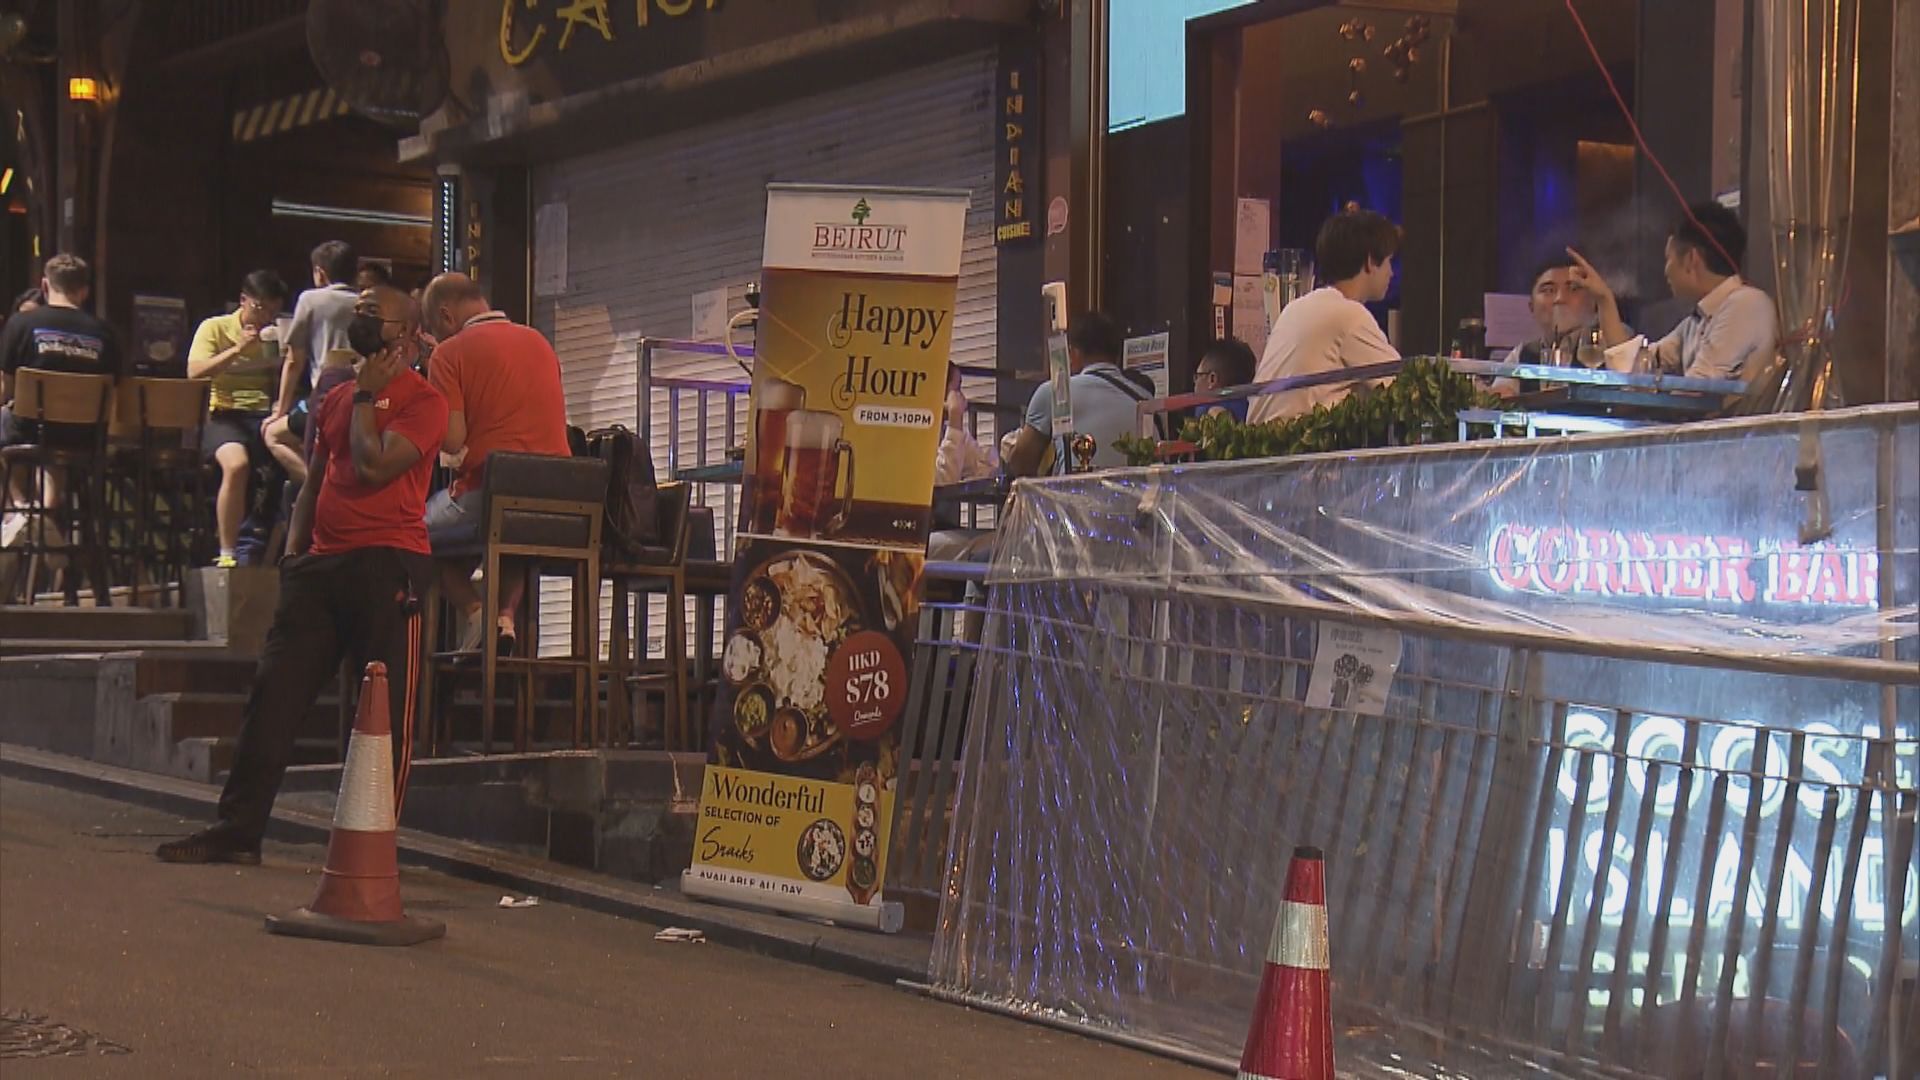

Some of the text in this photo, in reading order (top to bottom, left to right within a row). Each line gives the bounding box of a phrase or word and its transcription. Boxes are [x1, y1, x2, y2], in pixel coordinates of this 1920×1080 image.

[1003, 71, 1025, 219] INDIAN
[467, 202, 482, 281] INDI
[814, 225, 907, 250] BEIRUT
[997, 221, 1032, 241] CUISINE
[828, 292, 948, 349] Happy
[833, 355, 928, 408] Hour
[860, 409, 889, 422] FROM
[1489, 521, 1756, 603] CORNER
[849, 650, 880, 671] HKD
[846, 669, 889, 704] $78
[711, 771, 825, 814] Wonderful
[704, 805, 781, 827] SELECTION OF
[701, 825, 754, 863] Snacks
